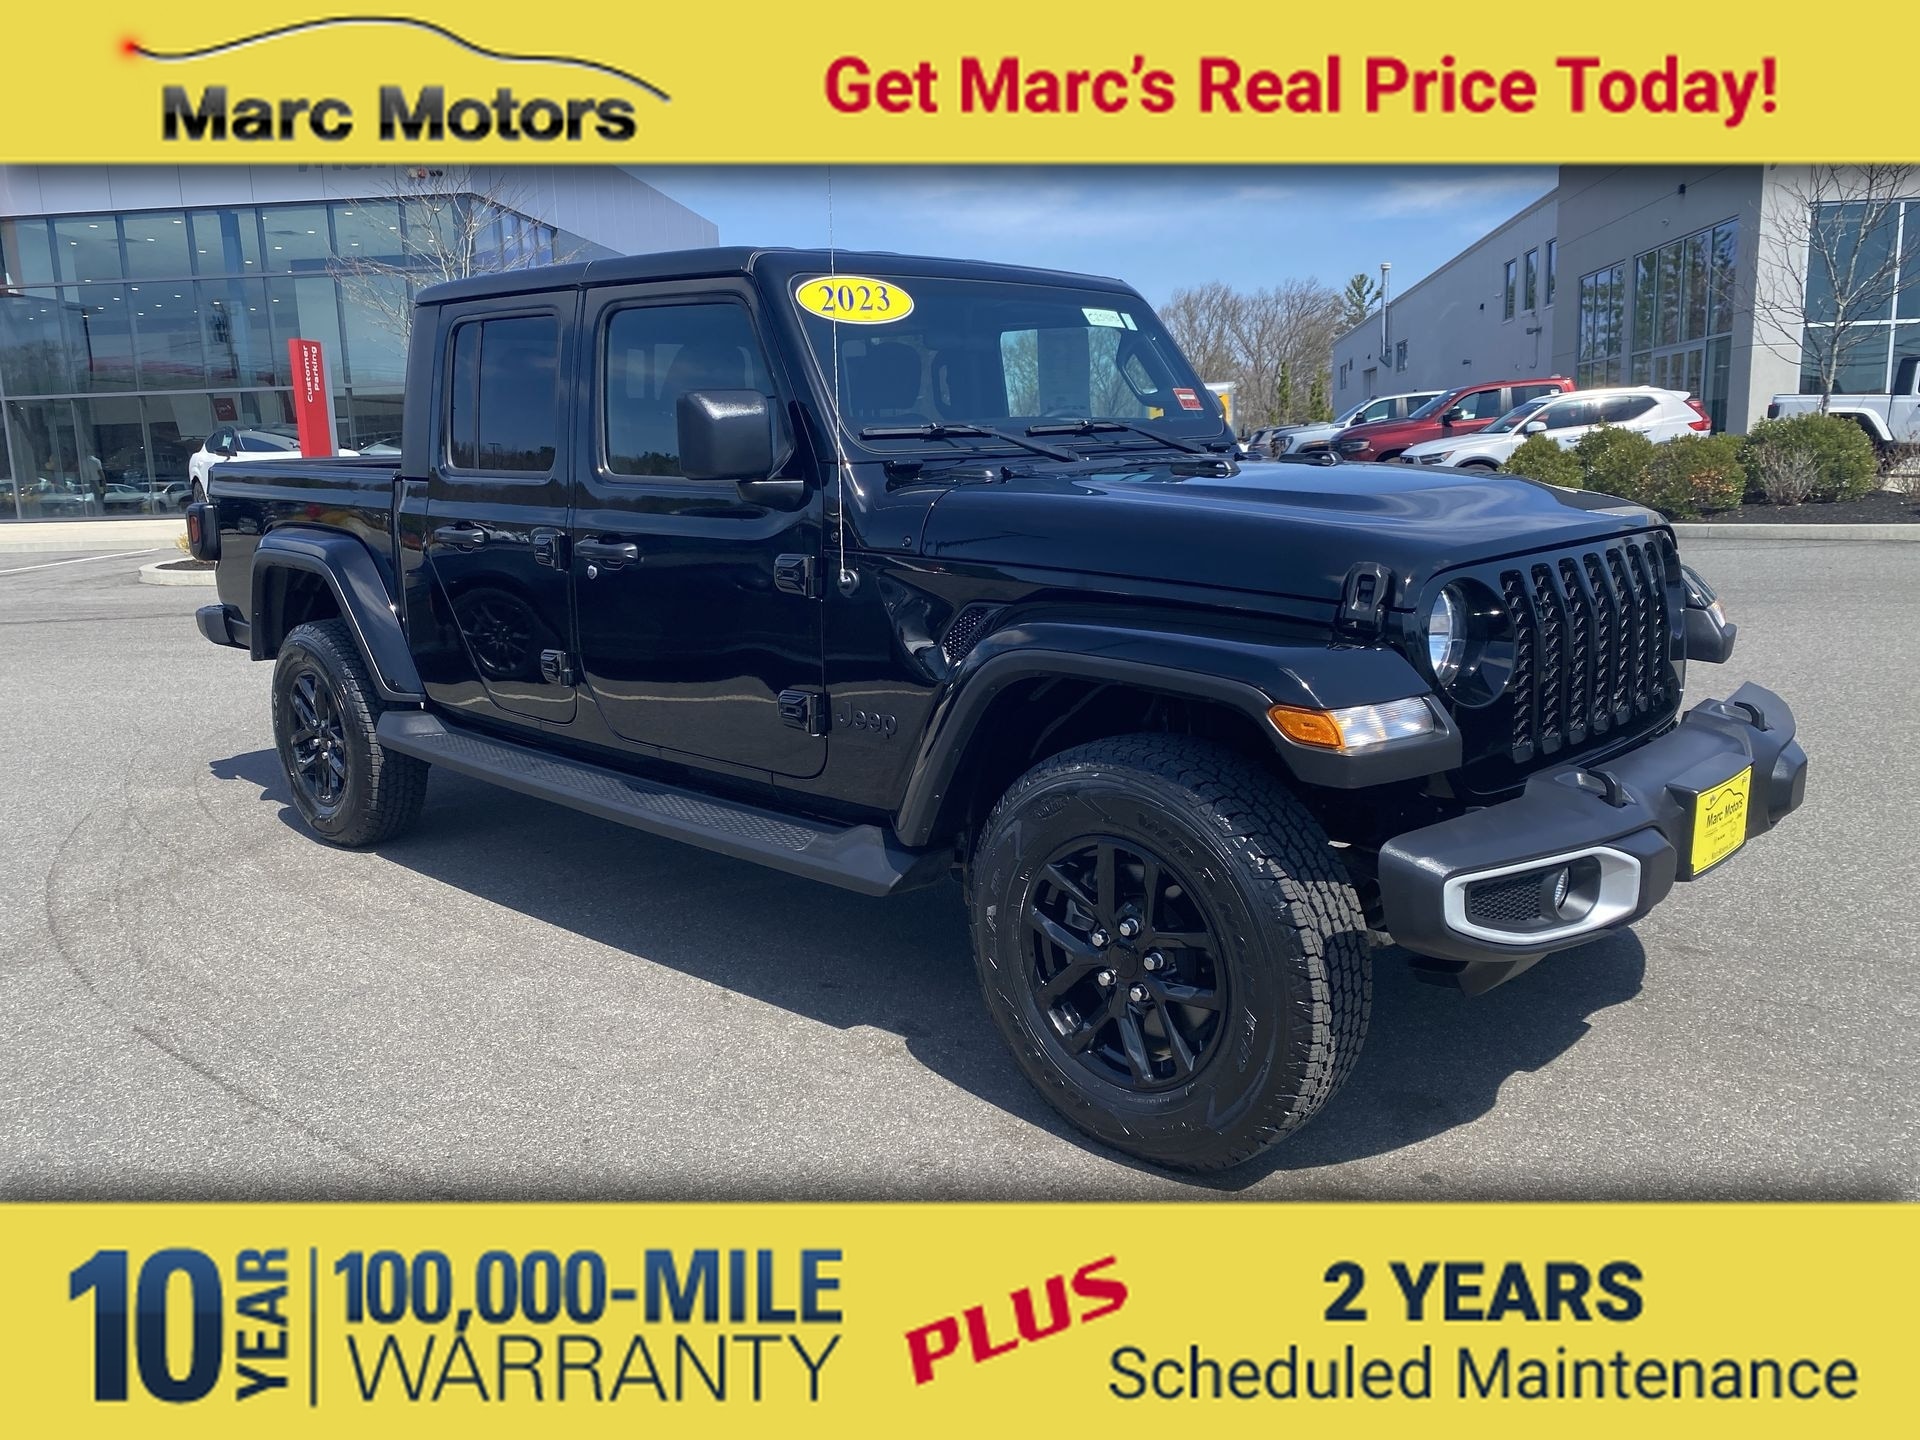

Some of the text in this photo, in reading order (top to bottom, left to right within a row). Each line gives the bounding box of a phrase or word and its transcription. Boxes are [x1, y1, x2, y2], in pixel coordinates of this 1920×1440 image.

[818, 284, 891, 312] 2023
[303, 345, 313, 403] Customer
[311, 346, 320, 391] Parking
[836, 701, 898, 739] Jeep
[1706, 812, 1724, 828] Marc
[1724, 799, 1743, 819] Motors
